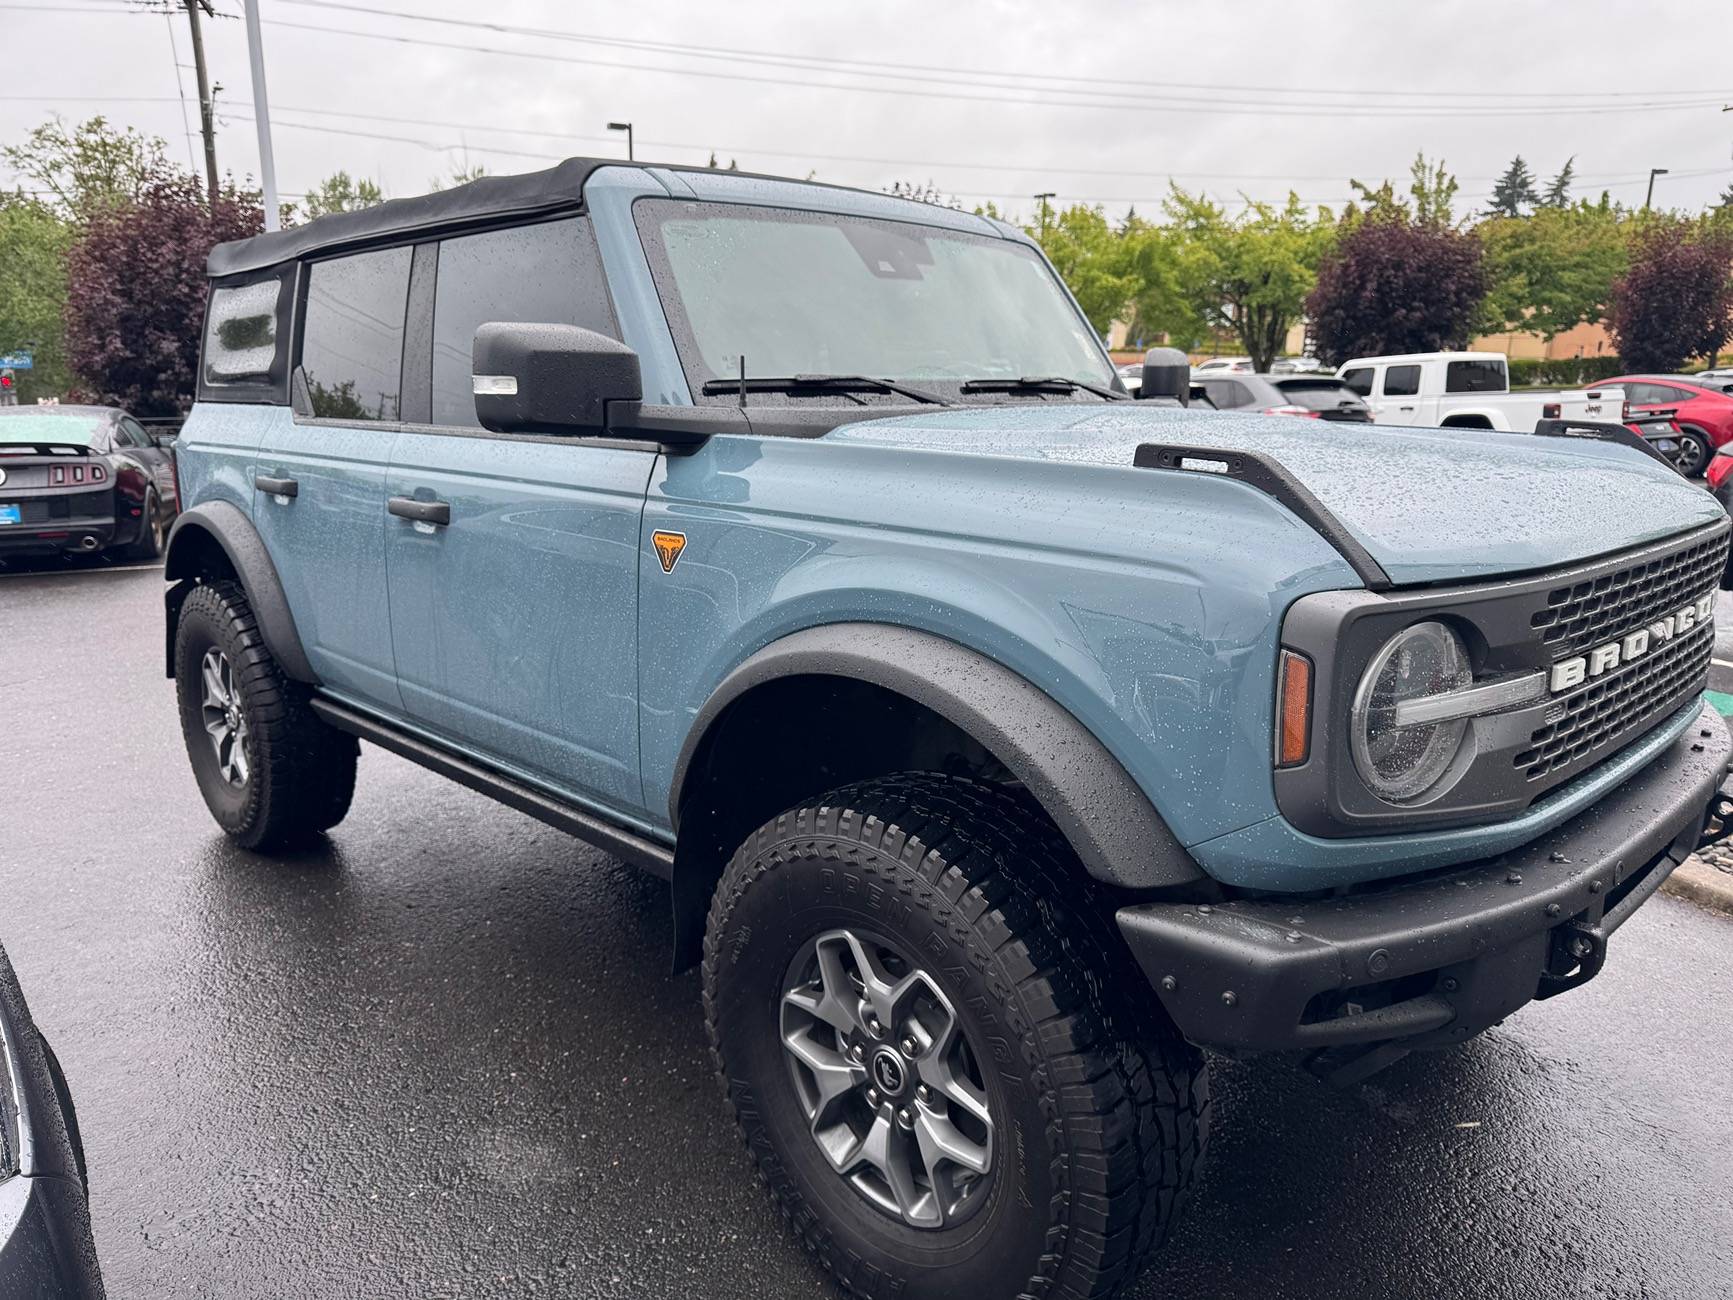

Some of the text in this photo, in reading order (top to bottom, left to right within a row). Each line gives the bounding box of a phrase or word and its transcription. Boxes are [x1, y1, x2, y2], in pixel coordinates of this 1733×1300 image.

[1584, 404, 1602, 414] Jeep
[1550, 595, 1713, 692] BRONCO
[819, 867, 913, 926] OPEN
